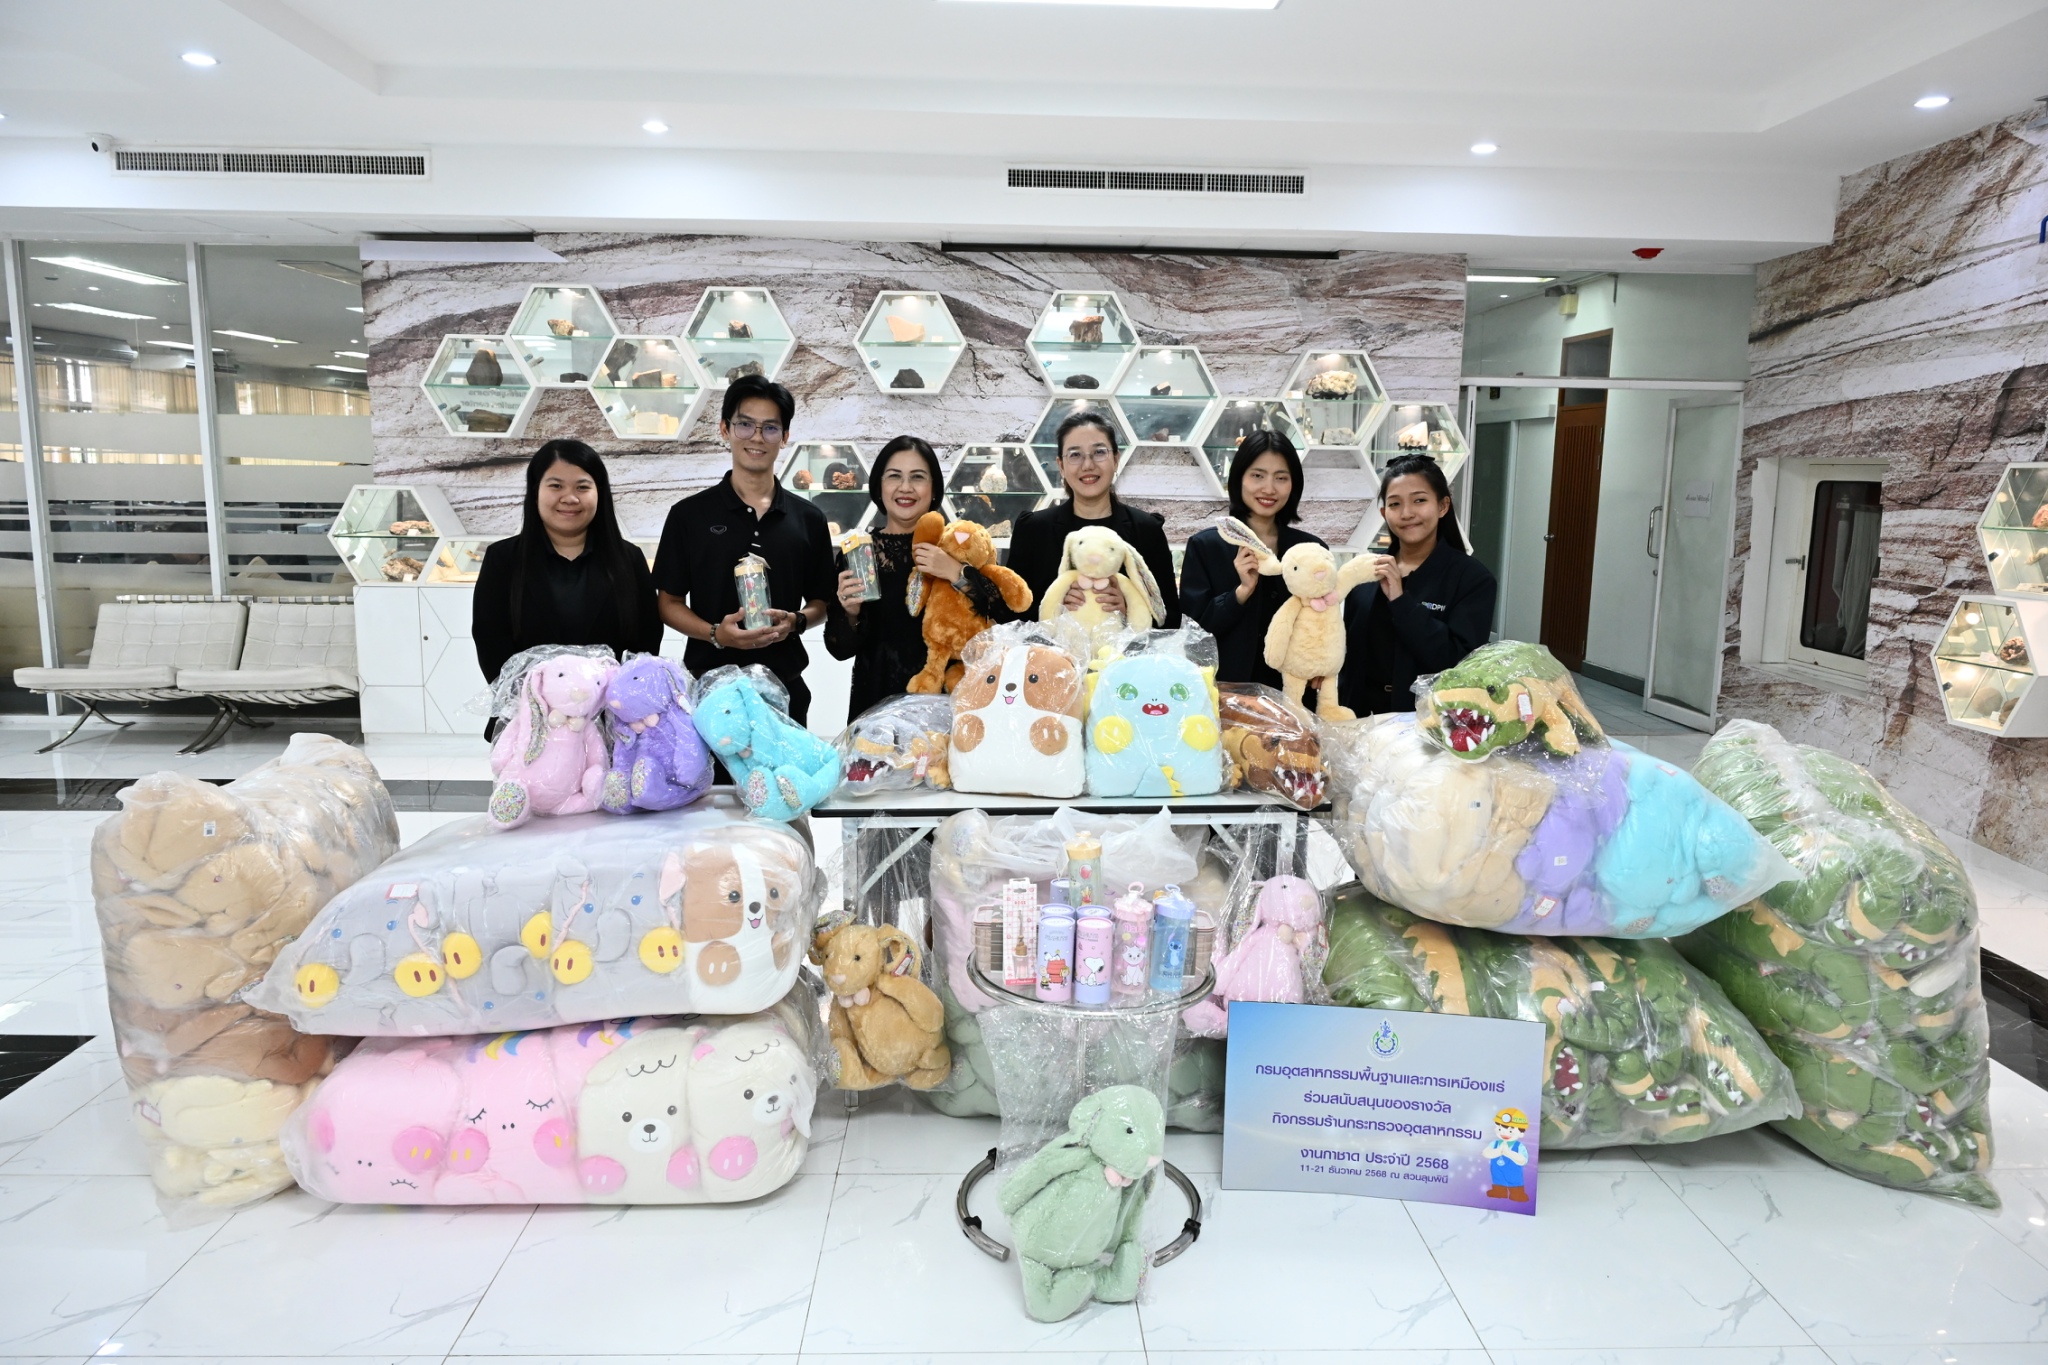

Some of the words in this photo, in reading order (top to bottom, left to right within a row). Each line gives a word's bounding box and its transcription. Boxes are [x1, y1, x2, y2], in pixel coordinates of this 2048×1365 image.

[1255, 1064, 1505, 1093] กรมอุตสาหกรรมพื้นฐานและการเหมืองแร่
[1304, 1092, 1451, 1114] ร่วมสนับสนุนของรางวัล
[1272, 1112, 1482, 1140] กิจกรรมร้านกระทรวงอุตสาหกรรม
[1301, 1148, 1360, 1162] งานกาชาด
[1365, 1150, 1411, 1167] ประจำปี
[1416, 1157, 1449, 1170] 2568
[1300, 1164, 1324, 1173] 11-21
[1328, 1165, 1362, 1176] ธันวาคม
[1365, 1169, 1387, 1178] 2568
[1403, 1171, 1449, 1184] สวนลุมพินี
